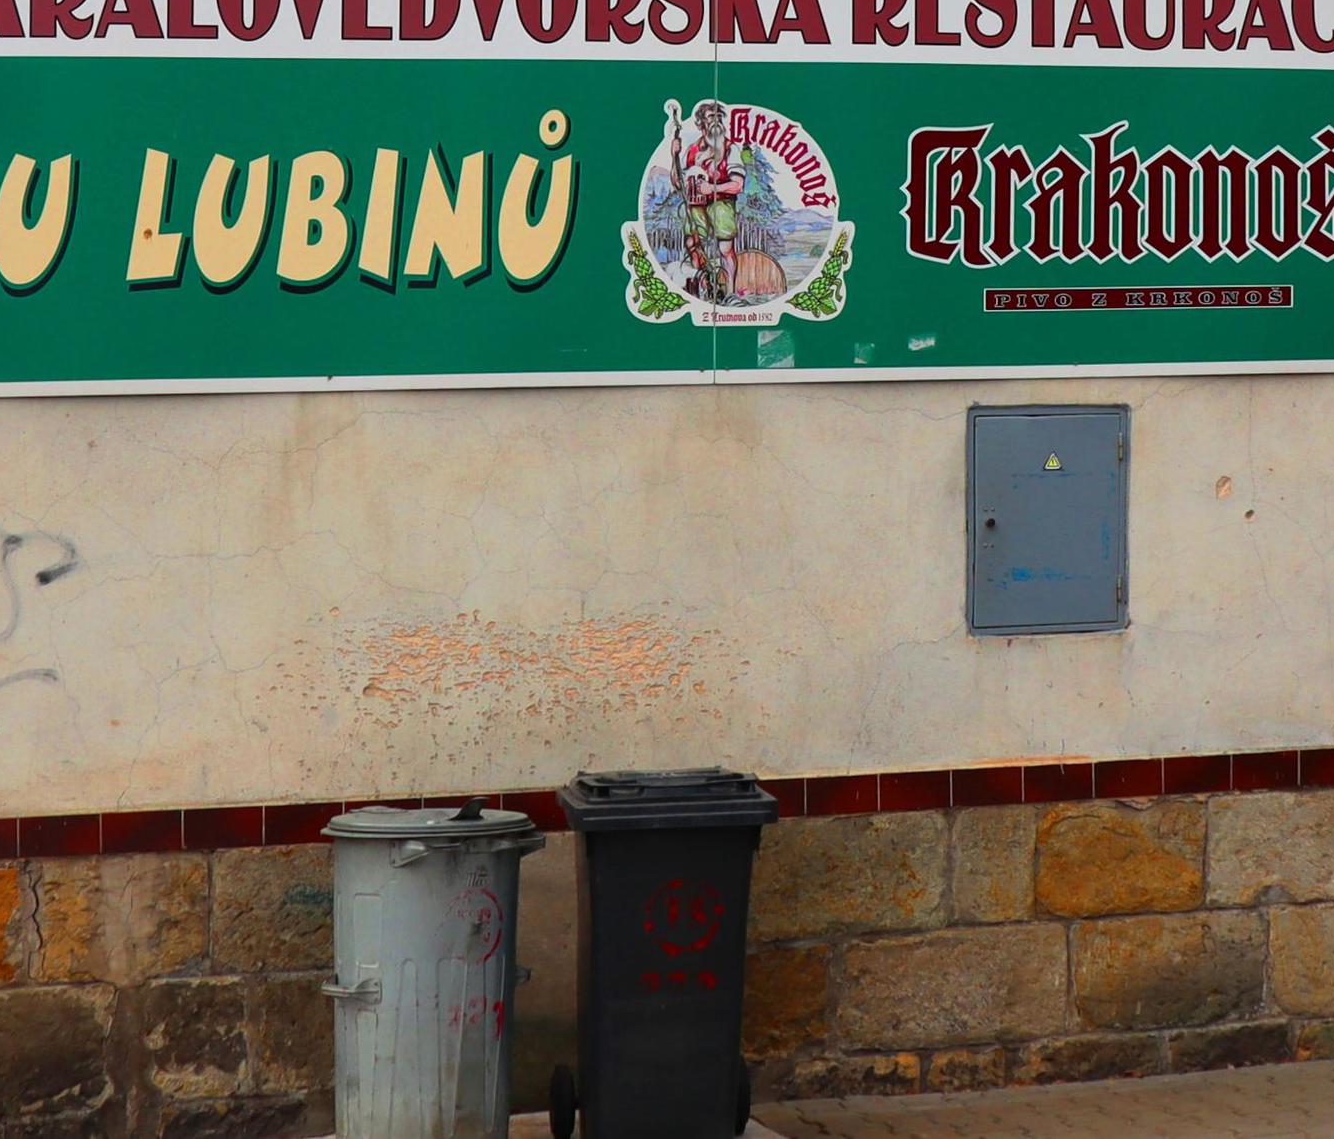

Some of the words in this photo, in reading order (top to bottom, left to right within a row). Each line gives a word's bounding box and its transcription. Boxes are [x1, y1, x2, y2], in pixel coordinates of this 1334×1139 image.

[729, 107, 837, 208] Krakonoš
[125, 109, 576, 290] LUBINŮ
[748, 312, 757, 322] od
[994, 293, 1072, 308] PIVO
[1091, 293, 1107, 306] Z
[1125, 287, 1283, 306] KRKONOŠ
